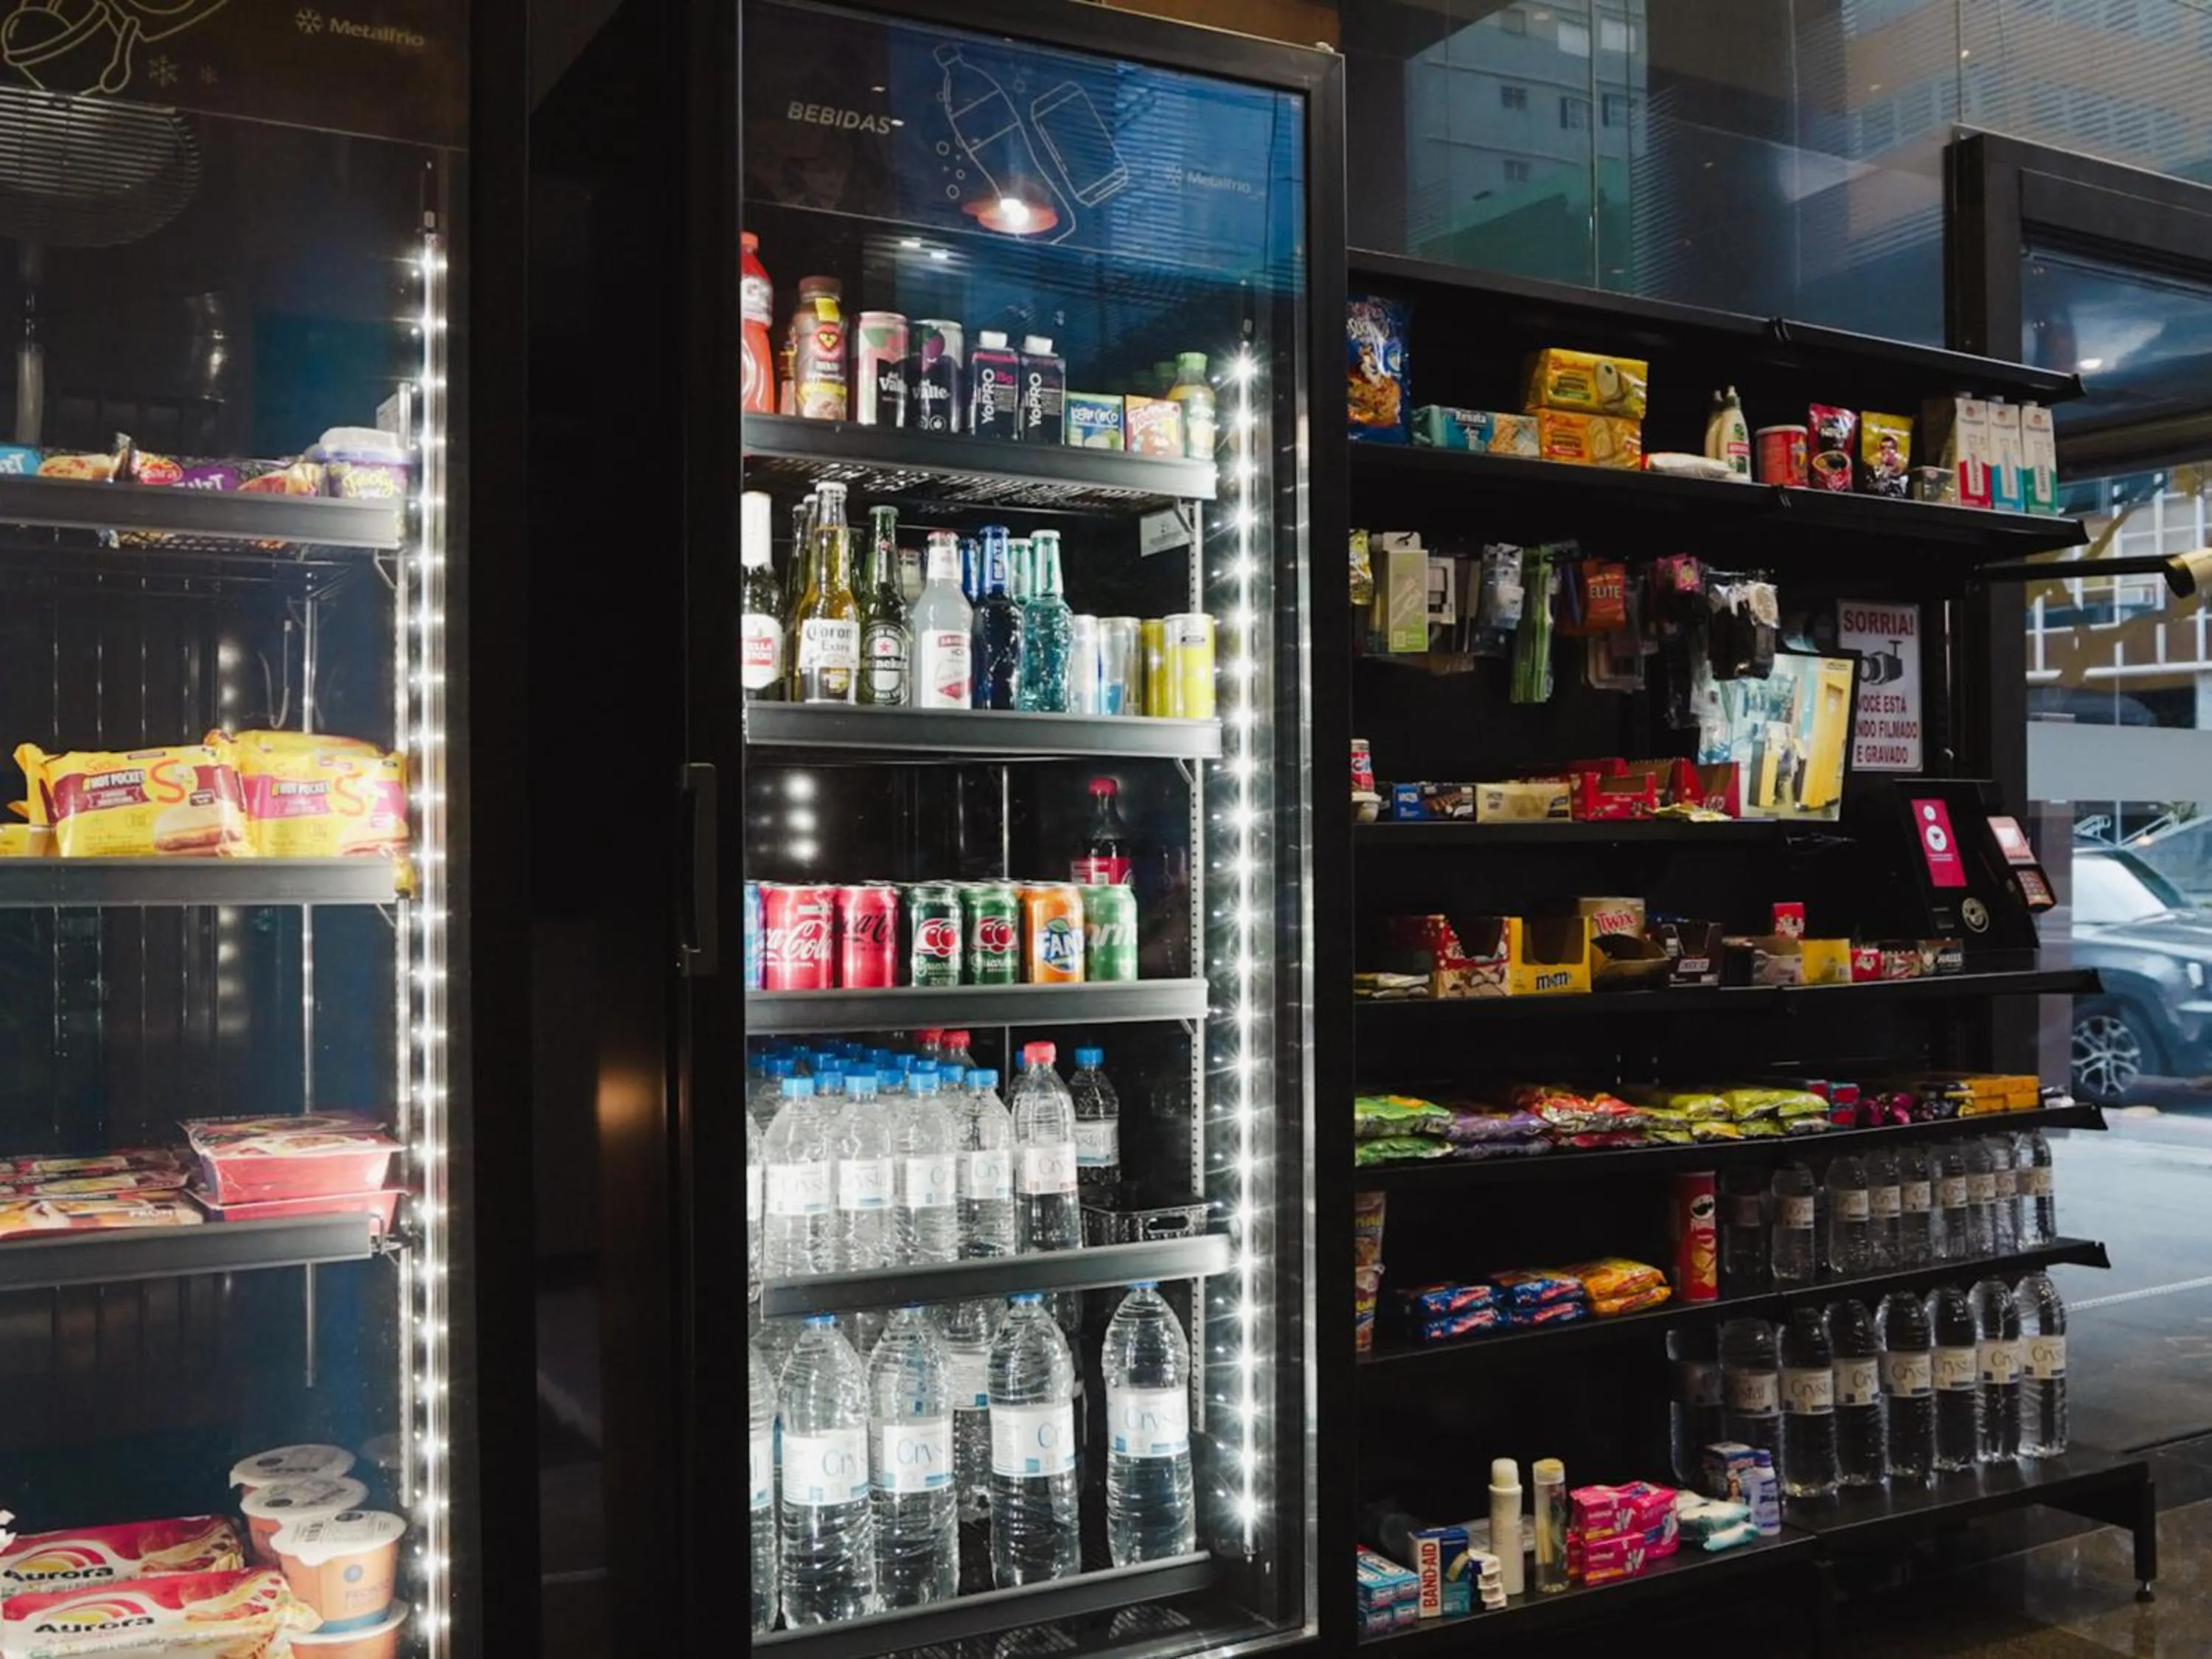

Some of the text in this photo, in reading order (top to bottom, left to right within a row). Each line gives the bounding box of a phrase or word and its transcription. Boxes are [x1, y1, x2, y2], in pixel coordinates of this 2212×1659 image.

[329, 18, 425, 47] Metalfrio
[787, 101, 891, 136] BEBIDAS
[1186, 170, 1251, 195] Metalfrio
[981, 368, 995, 424] YoPRO
[1029, 372, 1042, 427] YoPRO
[1589, 585, 1621, 599] ELITE
[1844, 609, 1914, 636] SORRIA!
[1856, 720, 1918, 739] NDO FILMADO
[1857, 745, 1908, 764] E GRAVADO
[3, 1567, 114, 1582] Aurora
[1422, 1542, 1439, 1608] BAND-AID
[34, 1616, 154, 1632] Aurora
